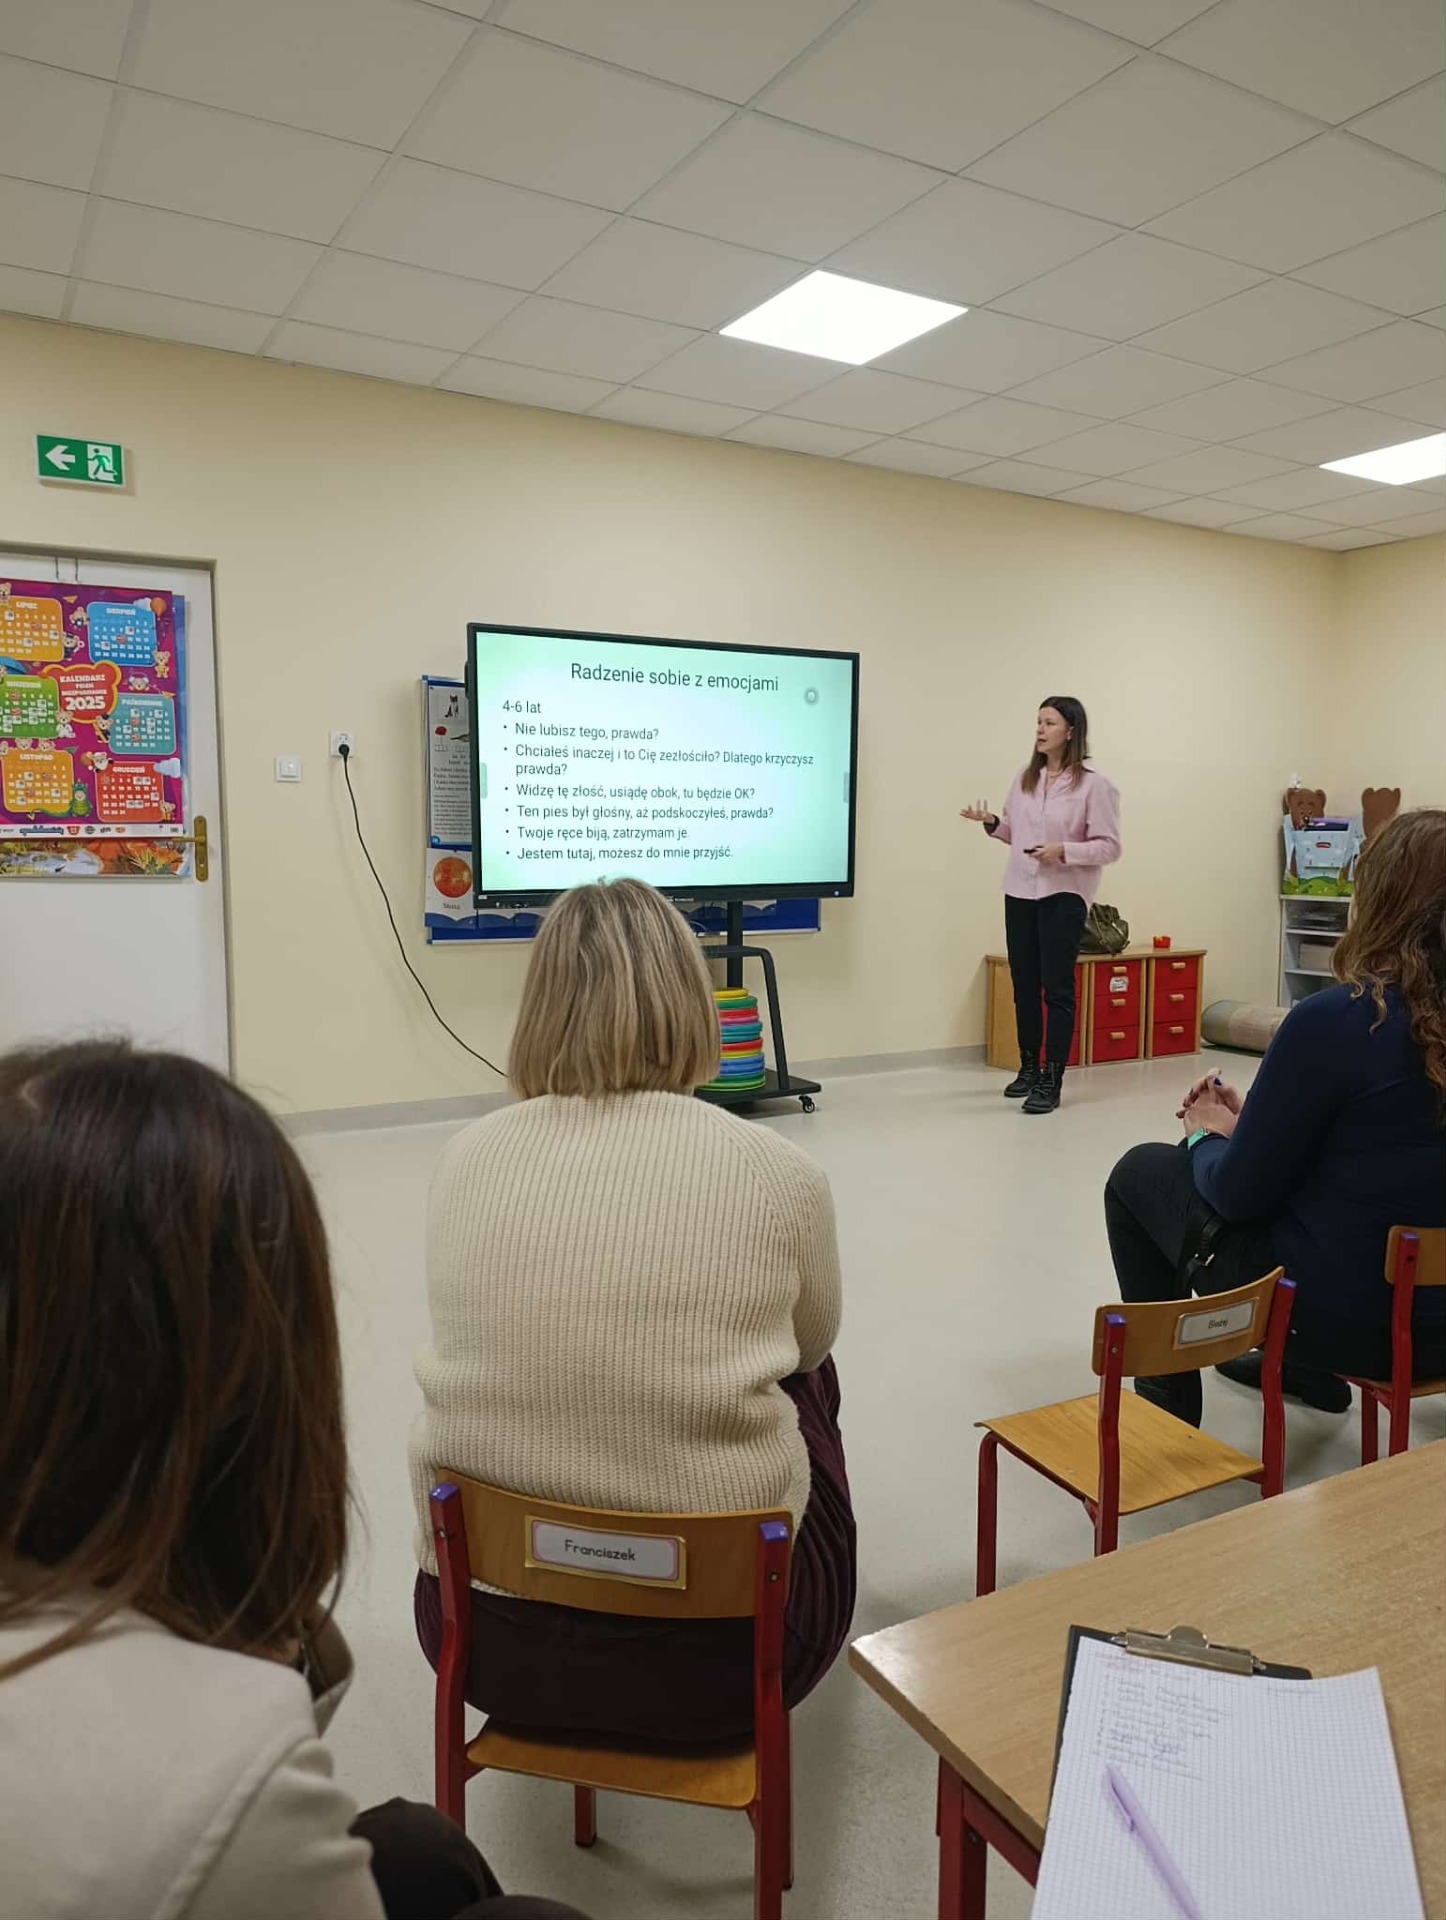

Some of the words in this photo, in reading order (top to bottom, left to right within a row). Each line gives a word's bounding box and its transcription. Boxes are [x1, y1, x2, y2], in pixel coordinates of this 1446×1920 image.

[571, 662, 644, 683] Radzenie
[649, 669, 690, 686] sobie
[695, 675, 702, 686] z
[708, 675, 779, 694] emocjami
[65, 696, 106, 711] 2025
[502, 700, 522, 713] 4-6
[526, 700, 542, 714] lat
[515, 722, 536, 736] Nie
[540, 723, 576, 738] lubisz
[579, 726, 608, 740] tego,
[611, 728, 659, 741] prawda?
[516, 744, 569, 758] Chciałeś
[572, 746, 614, 762] inaczej
[618, 748, 620, 760] i
[624, 749, 635, 760] to
[638, 748, 656, 763] Cię
[660, 748, 720, 763] zezłościło?
[724, 751, 762, 766] Dlatego
[765, 752, 814, 767] krzyczysz
[516, 762, 568, 777] prawda?
[516, 784, 554, 798] Widzę
[558, 785, 568, 799] tę
[572, 784, 607, 799] złość,
[610, 786, 647, 800] usiądę
[650, 786, 680, 800] obok,
[683, 788, 694, 798] tu
[697, 787, 732, 801] będzie
[734, 788, 755, 799] OK?
[517, 805, 539, 818] Ten
[543, 806, 568, 820] pies
[572, 806, 589, 820] był
[592, 806, 633, 820] głośny,
[652, 806, 728, 821] podskoczyłeś,
[730, 807, 774, 820] prawda?
[518, 826, 554, 841] Twoje
[558, 829, 583, 841] ręce
[586, 826, 610, 841] biją,
[613, 828, 674, 841] zatrzymam
[518, 848, 563, 860] Jestem
[567, 848, 596, 861] tutaj,
[598, 847, 643, 859] możesz
[646, 846, 660, 858] do
[663, 846, 690, 858] mnie
[564, 1539, 636, 1562] Franciszek
